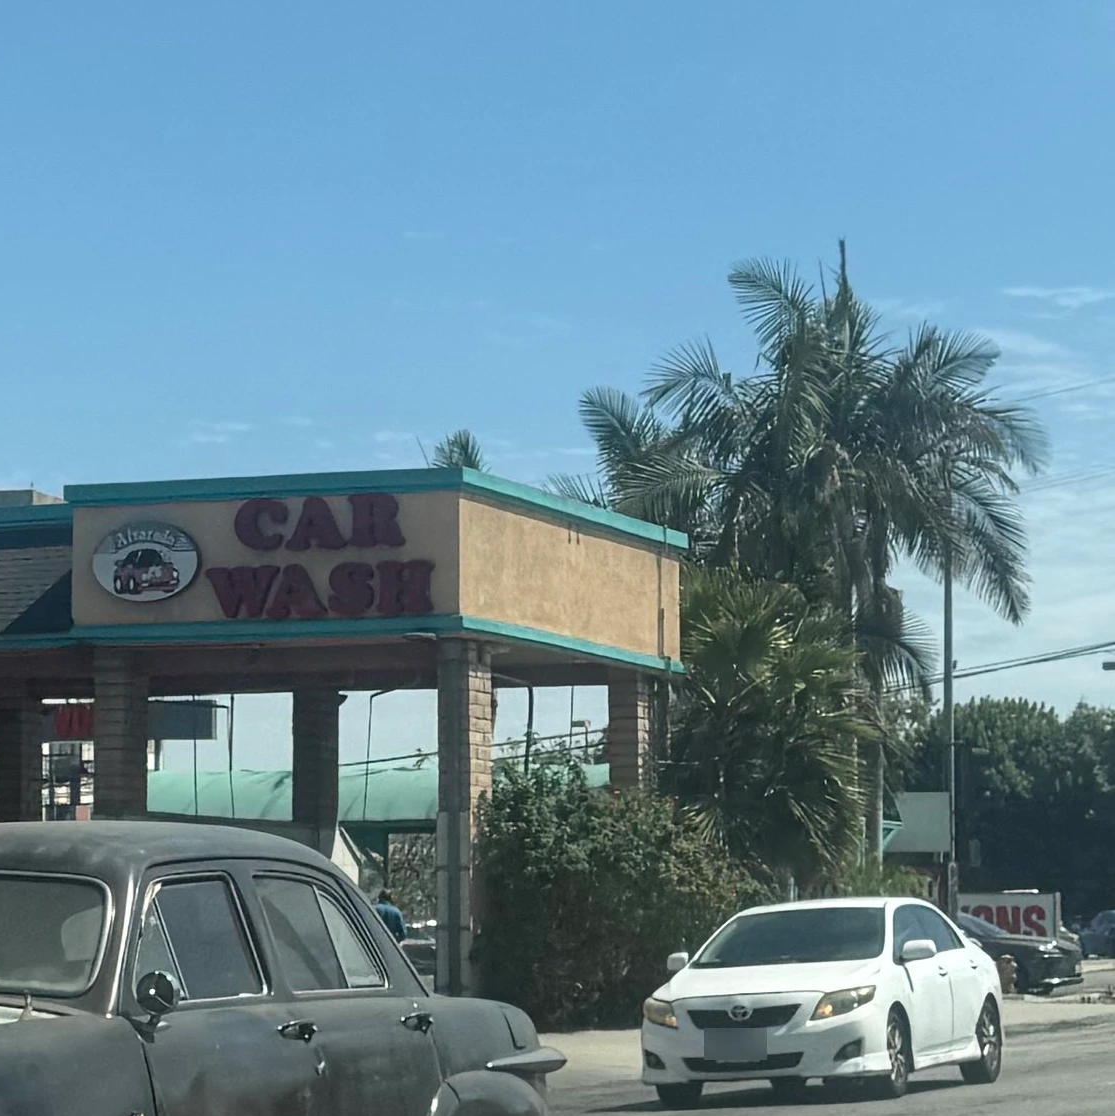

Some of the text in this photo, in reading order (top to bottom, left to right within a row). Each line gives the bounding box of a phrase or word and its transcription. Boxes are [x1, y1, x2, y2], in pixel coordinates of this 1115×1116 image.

[234, 493, 406, 551] CAR
[206, 559, 435, 618] WASH
[961, 905, 1047, 937] ONS
